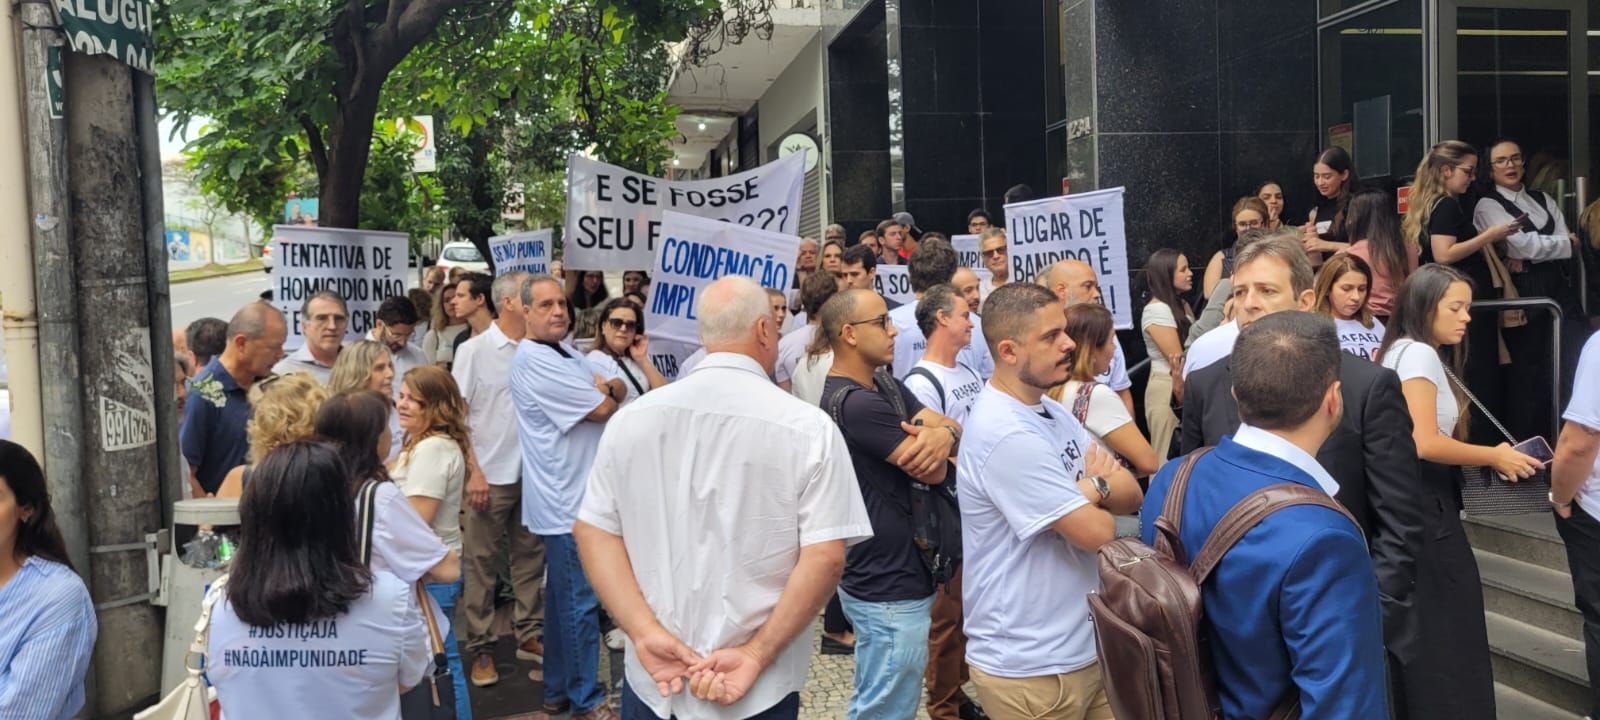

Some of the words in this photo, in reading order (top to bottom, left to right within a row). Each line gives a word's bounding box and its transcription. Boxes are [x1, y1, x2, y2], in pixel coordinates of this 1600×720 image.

[597, 174, 613, 202] E
[622, 176, 657, 205] SE
[669, 176, 759, 207] FOSSE
[576, 215, 634, 251] SEU
[1012, 212, 1073, 245] LUGAR
[1079, 207, 1106, 239] DE
[280, 242, 366, 270] TENTATIVA
[372, 246, 392, 270] DE
[517, 240, 545, 259] PUNIR
[1098, 240, 1112, 275] É
[372, 274, 403, 301] NÃO
[888, 273, 910, 295] SO
[651, 281, 697, 320] IMPL
[1340, 332, 1382, 343] AFAEL
[650, 354, 679, 378] ATAR
[224, 645, 368, 668] #NÃOÀIMPUNIDADE
